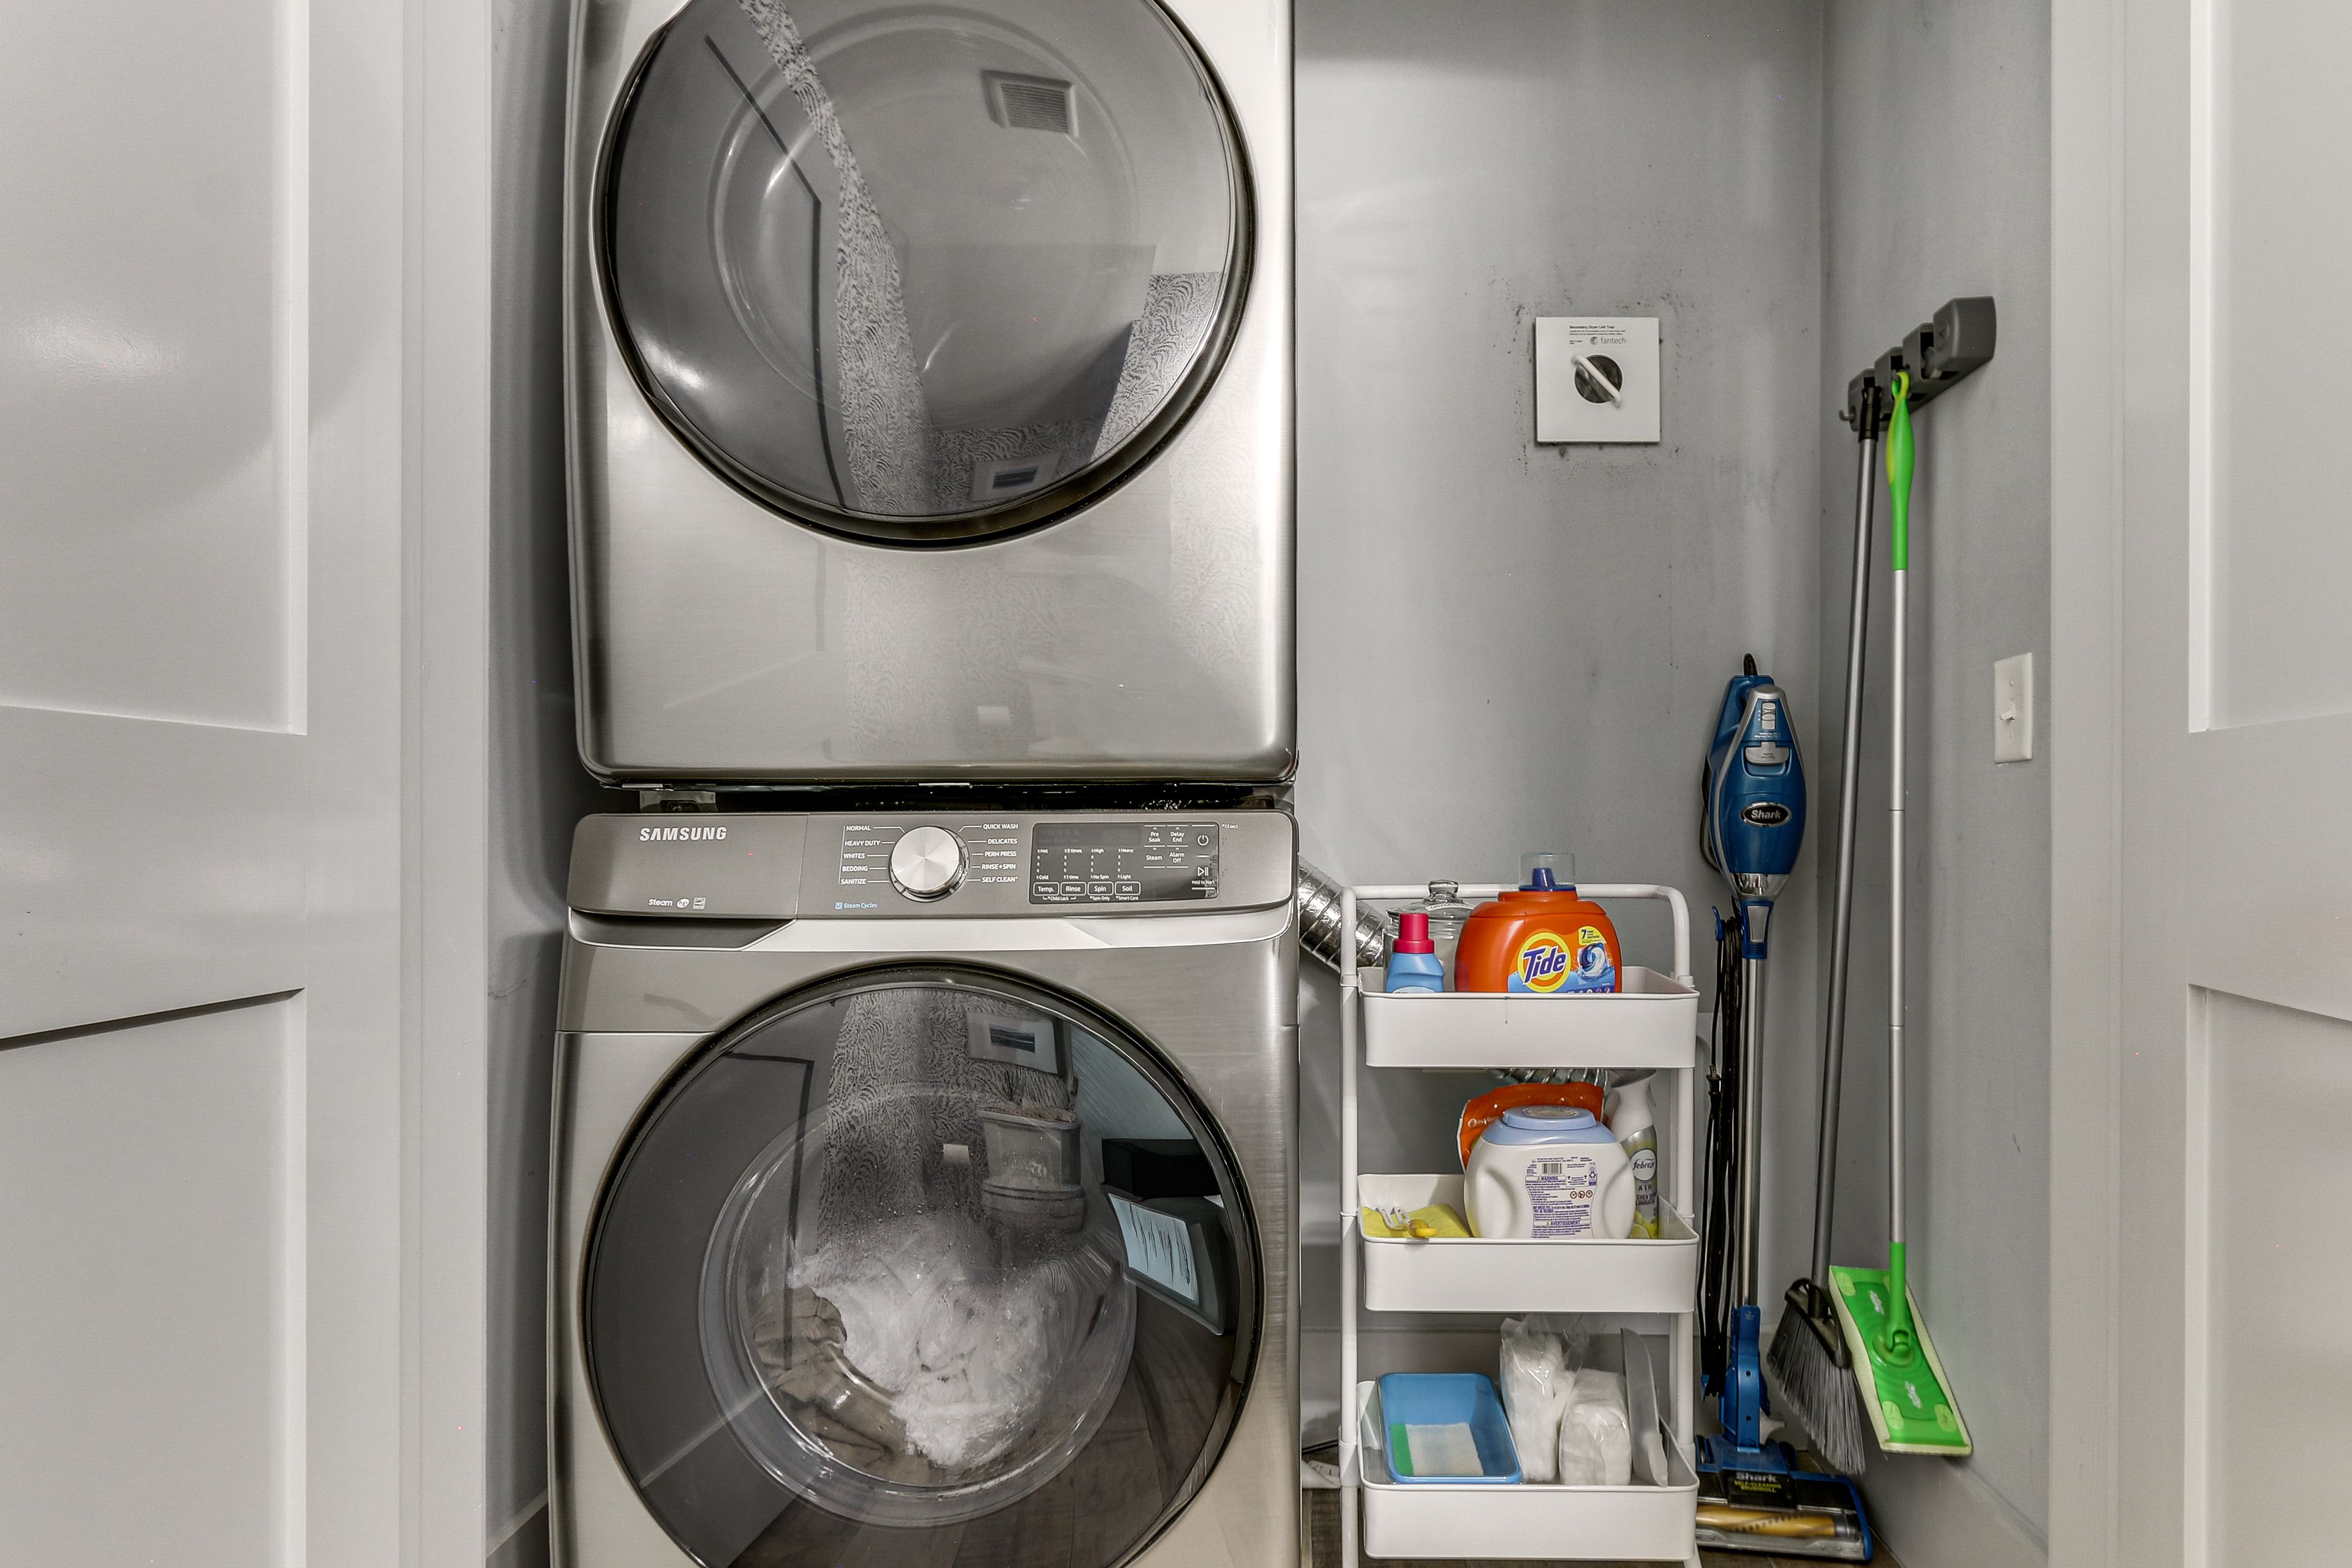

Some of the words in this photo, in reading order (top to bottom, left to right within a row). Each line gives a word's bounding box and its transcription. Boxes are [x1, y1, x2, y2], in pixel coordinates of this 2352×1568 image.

[1751, 809, 1781, 820] Shark
[639, 827, 727, 841] SAMSUNG
[1581, 929, 1587, 939] 7
[1522, 946, 1567, 985] Tide
[1736, 1472, 1777, 1482] Shark
